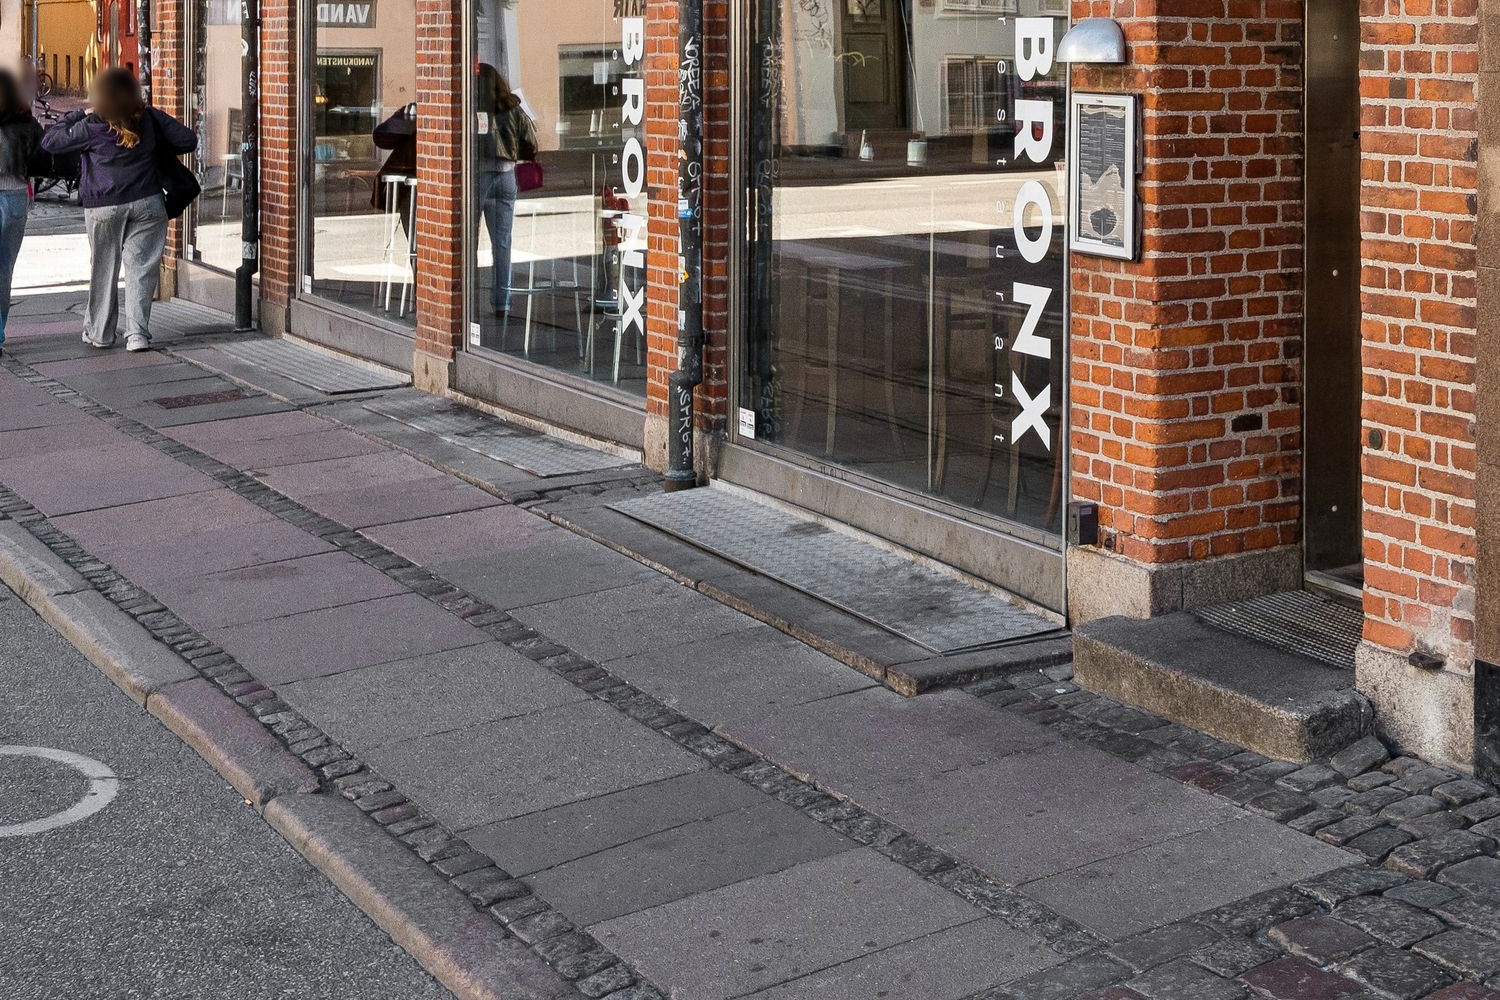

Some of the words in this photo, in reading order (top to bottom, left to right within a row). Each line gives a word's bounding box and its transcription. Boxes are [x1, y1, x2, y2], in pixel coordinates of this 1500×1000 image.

[621, 17, 644, 337] BRONX
[994, 16, 1006, 443] restaurant
[1011, 16, 1054, 452] BRONX
